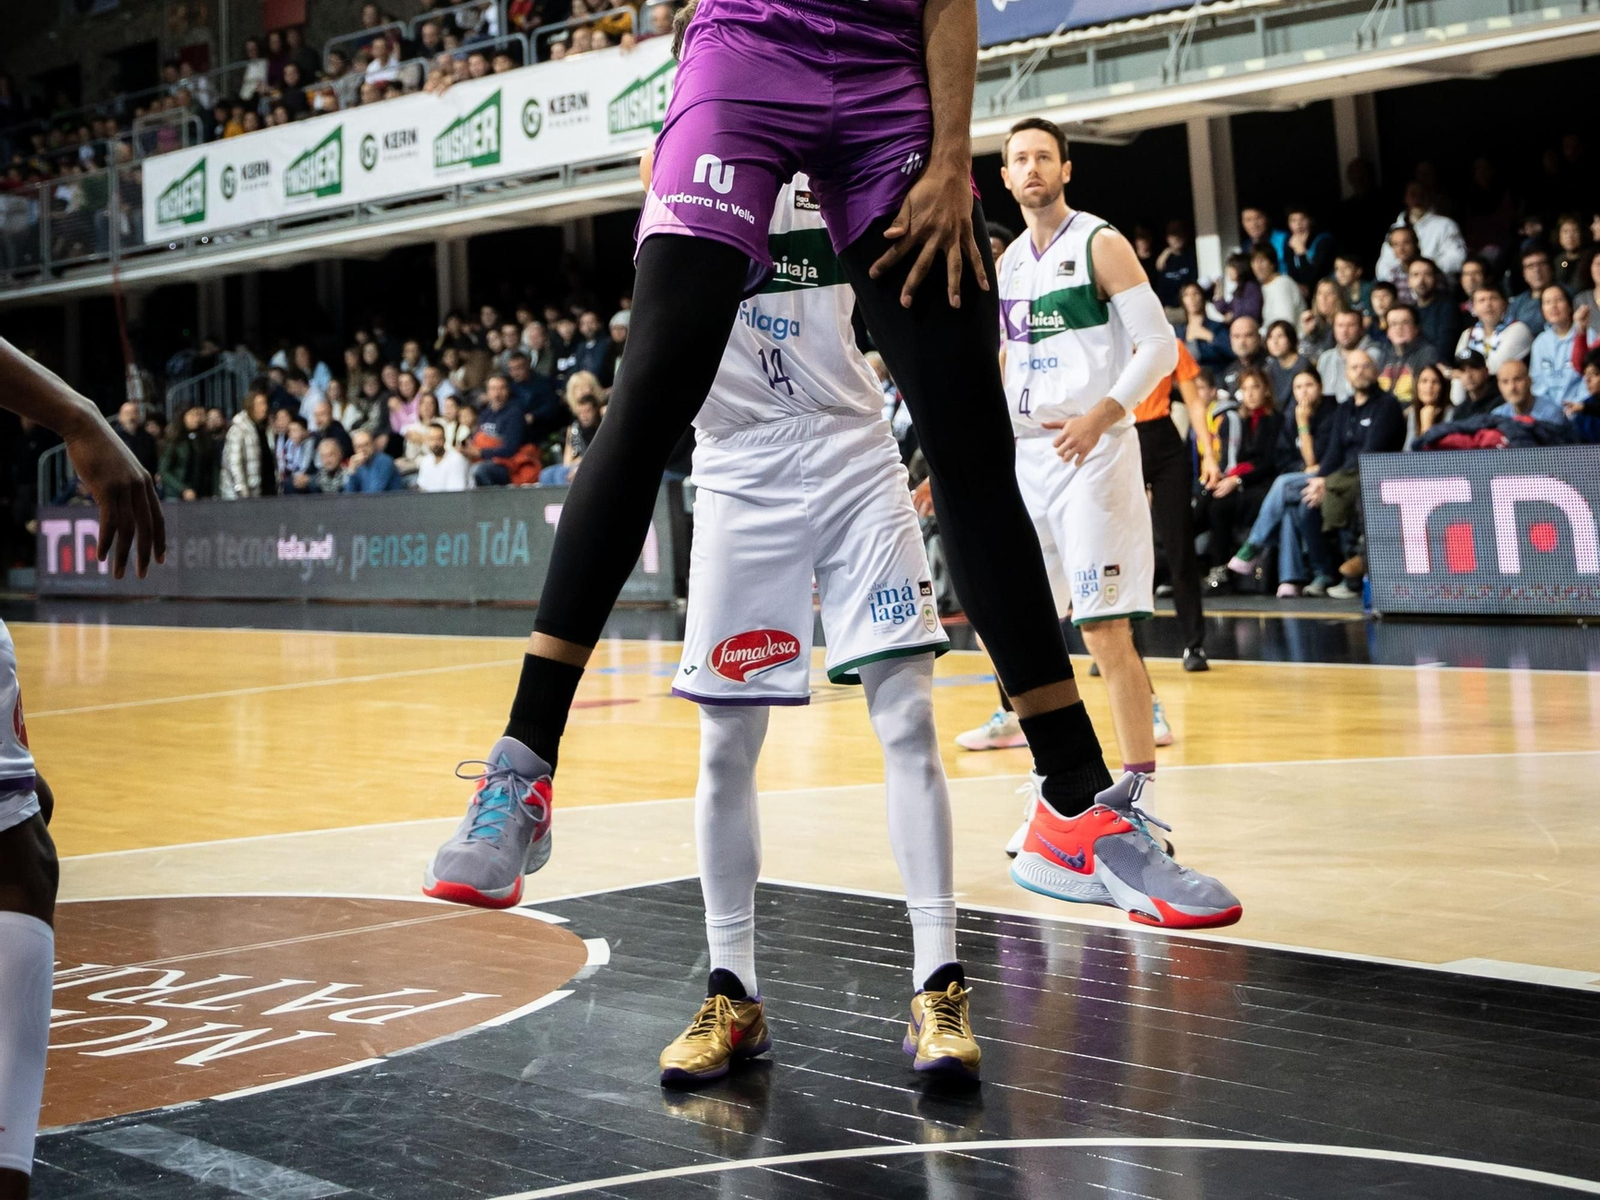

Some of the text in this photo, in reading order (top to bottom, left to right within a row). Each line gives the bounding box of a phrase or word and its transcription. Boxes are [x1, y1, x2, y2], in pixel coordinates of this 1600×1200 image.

[434, 103, 499, 167] FINISHER
[548, 90, 589, 115] KERN
[661, 191, 756, 225] Andorra la Vella
[772, 255, 819, 282] nicaja
[758, 348, 795, 396] 14
[1019, 388, 1033, 421] 4
[352, 532, 427, 581] pensa
[435, 532, 470, 567] en
[477, 517, 531, 567] TdA
[875, 578, 916, 606] má
[869, 602, 918, 626] laga
[715, 632, 797, 671] famadesa
